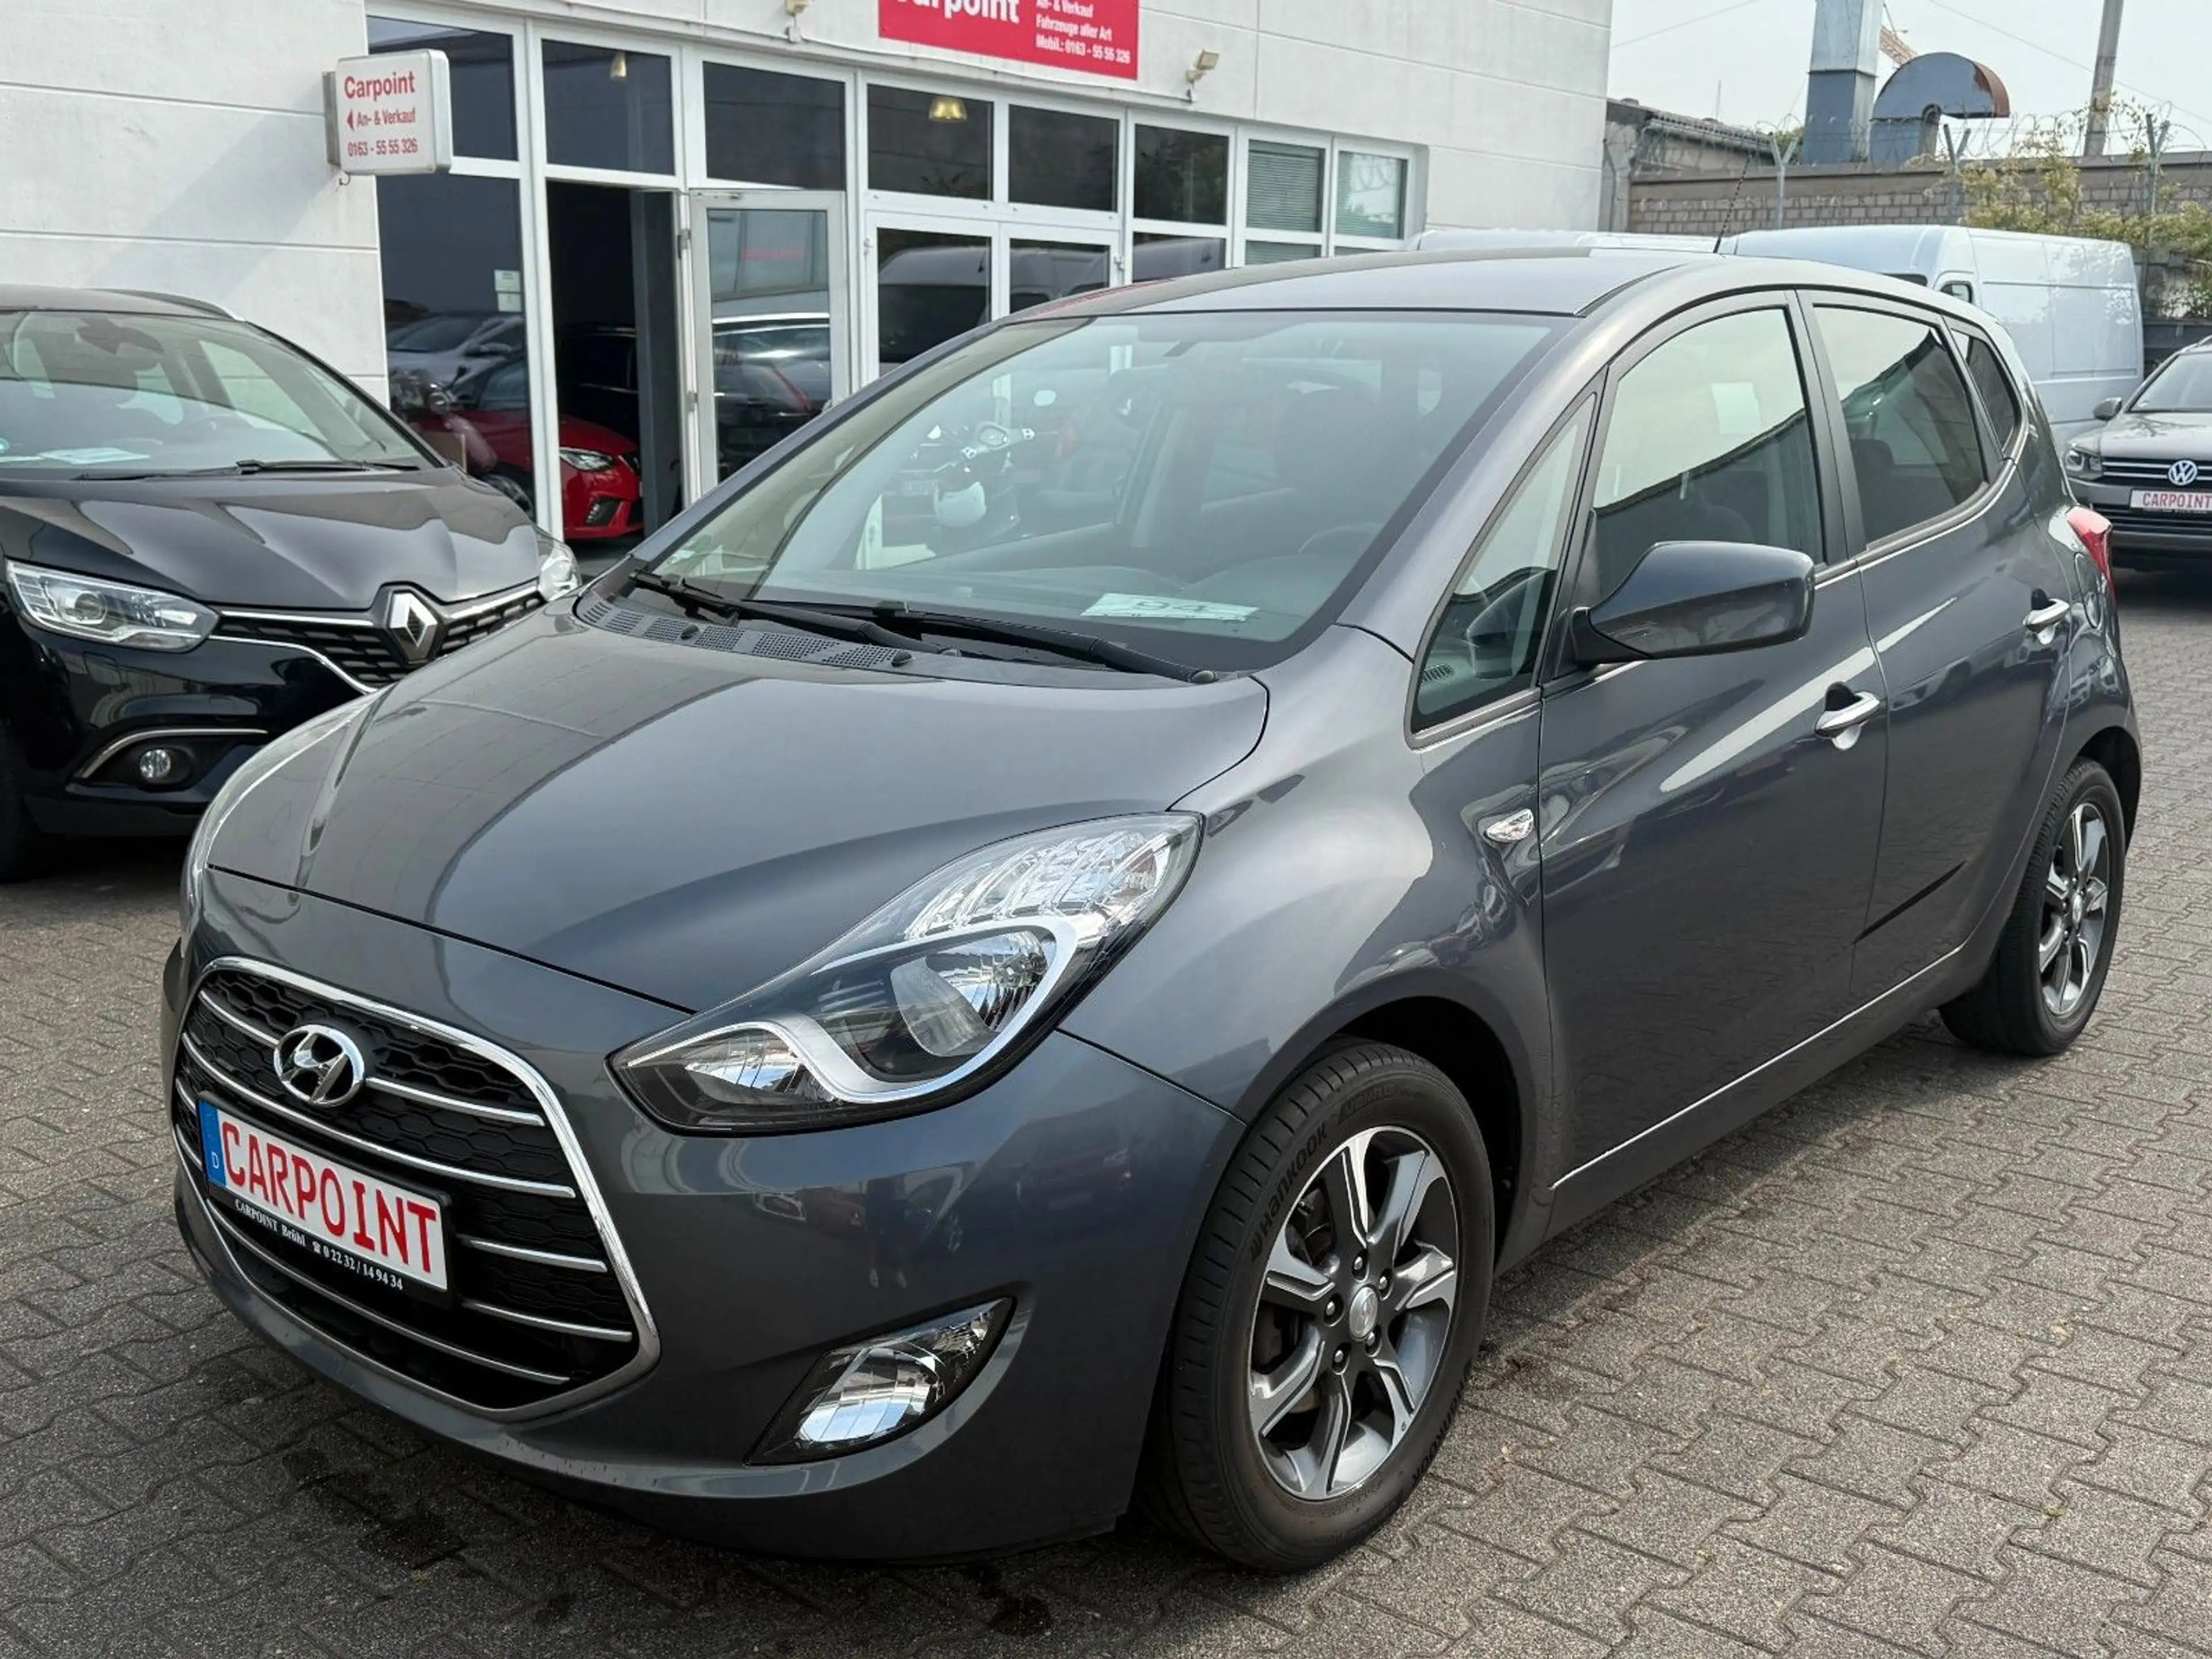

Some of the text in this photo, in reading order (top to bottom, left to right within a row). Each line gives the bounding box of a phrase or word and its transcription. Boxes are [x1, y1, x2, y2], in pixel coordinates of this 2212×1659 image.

[897, 0, 1020, 24] point
[1062, 0, 1093, 18] Verkauf
[1036, 13, 1112, 42] Fahrzeuge aller Art
[1065, 39, 1086, 56] 0163
[1092, 44, 1103, 60] 55
[1103, 46, 1115, 61] 55
[344, 71, 415, 102] Carpoint
[356, 107, 416, 127] An- & Verkauf
[347, 142, 369, 157] 0163
[376, 139, 387, 156] 55
[388, 138, 399, 155] 55
[400, 137, 418, 154] 326
[2142, 492, 2212, 509] CARPOINT
[211, 1151, 219, 1169] D
[222, 1121, 438, 1274] CARPOINT
[235, 1199, 279, 1232] CARPOINT
[282, 1224, 307, 1247] Brühl
